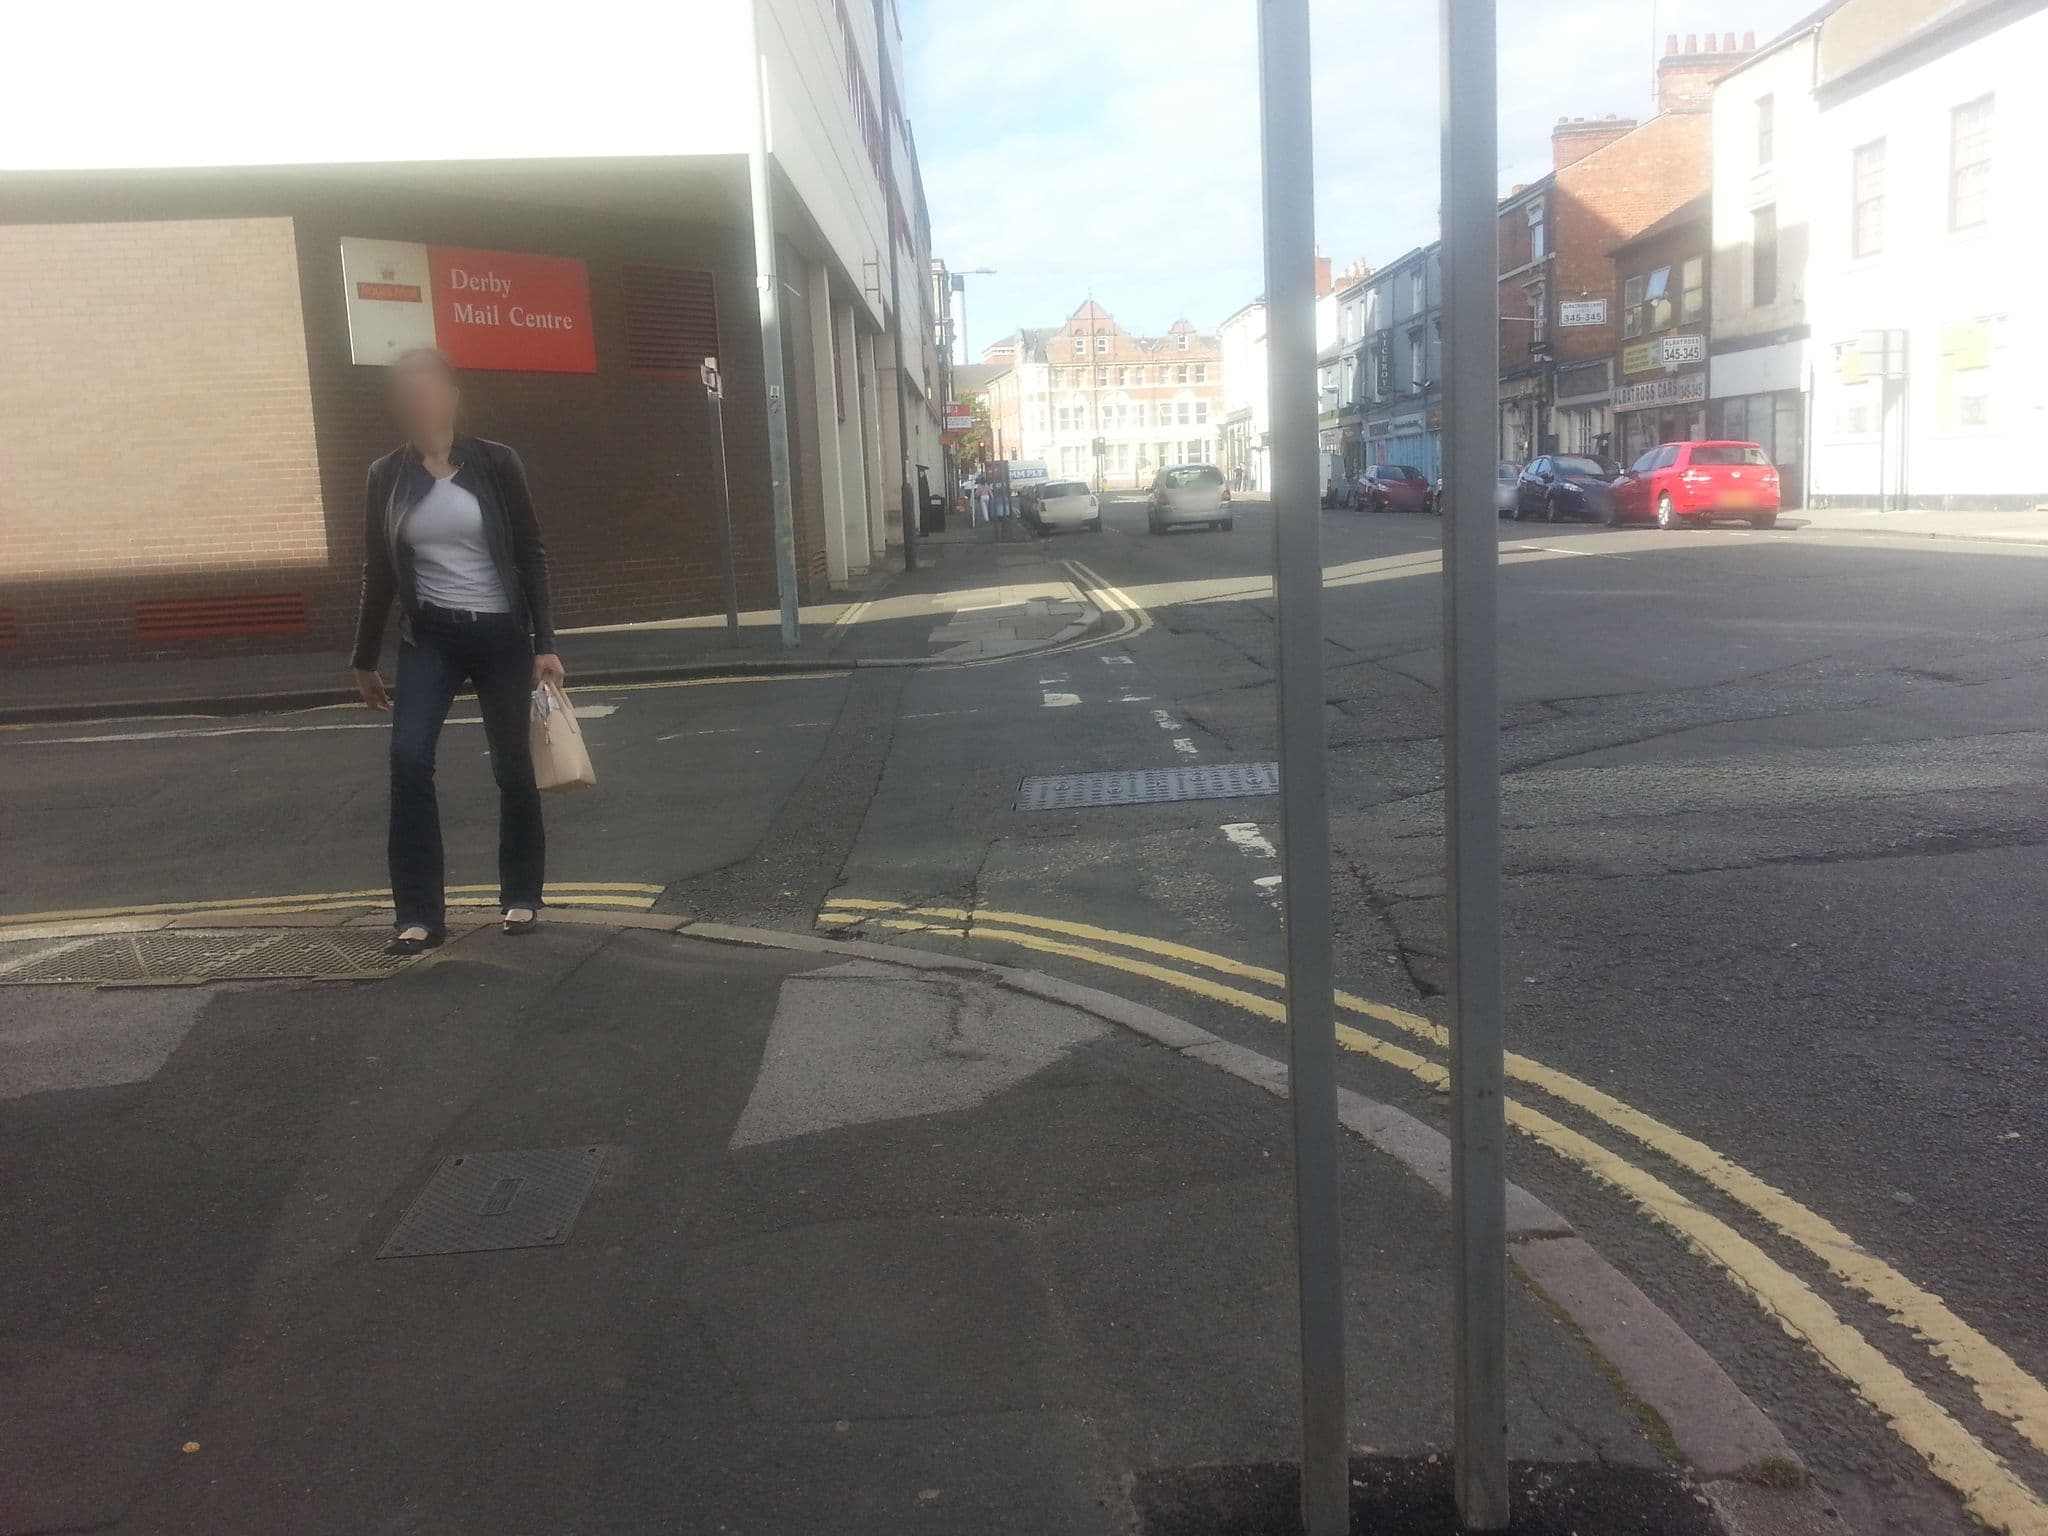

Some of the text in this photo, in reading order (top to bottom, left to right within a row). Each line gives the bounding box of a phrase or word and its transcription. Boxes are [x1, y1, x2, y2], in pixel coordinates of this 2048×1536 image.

[450, 268, 512, 299] Derby
[453, 302, 573, 330] Mail Centre
[1563, 313, 1602, 322] 345-345
[1664, 338, 1699, 347] ALBATROSS
[1664, 347, 1700, 361] 345-345
[1614, 385, 1656, 405] ALBATROSS
[1657, 381, 1677, 399] CARS
